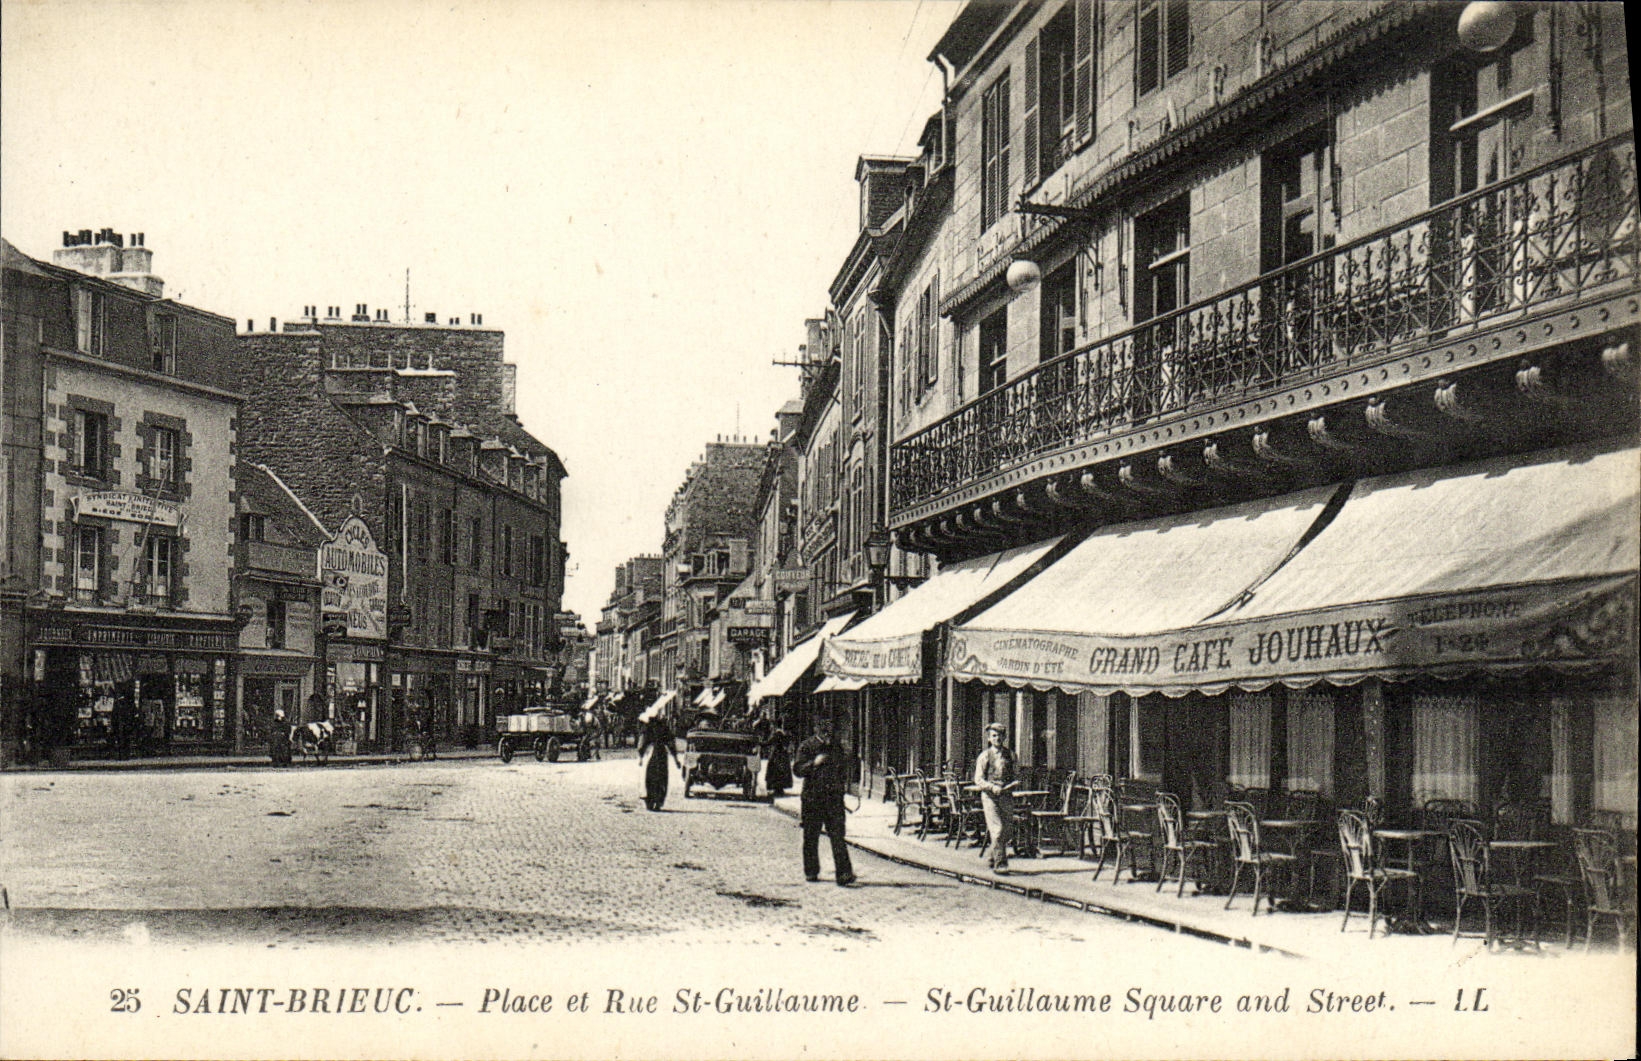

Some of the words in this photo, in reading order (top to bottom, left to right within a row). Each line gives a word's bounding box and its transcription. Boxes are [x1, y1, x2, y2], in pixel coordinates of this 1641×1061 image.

[345, 525, 370, 550] CYCLES
[325, 546, 386, 577] AUTOMOBILES
[730, 628, 767, 639] GARAGE
[1089, 646, 1160, 676] GRAND
[1173, 631, 1234, 673] CAFÉ
[1249, 617, 1387, 666] JOUHAUX
[998, 657, 1031, 673] JARDIN
